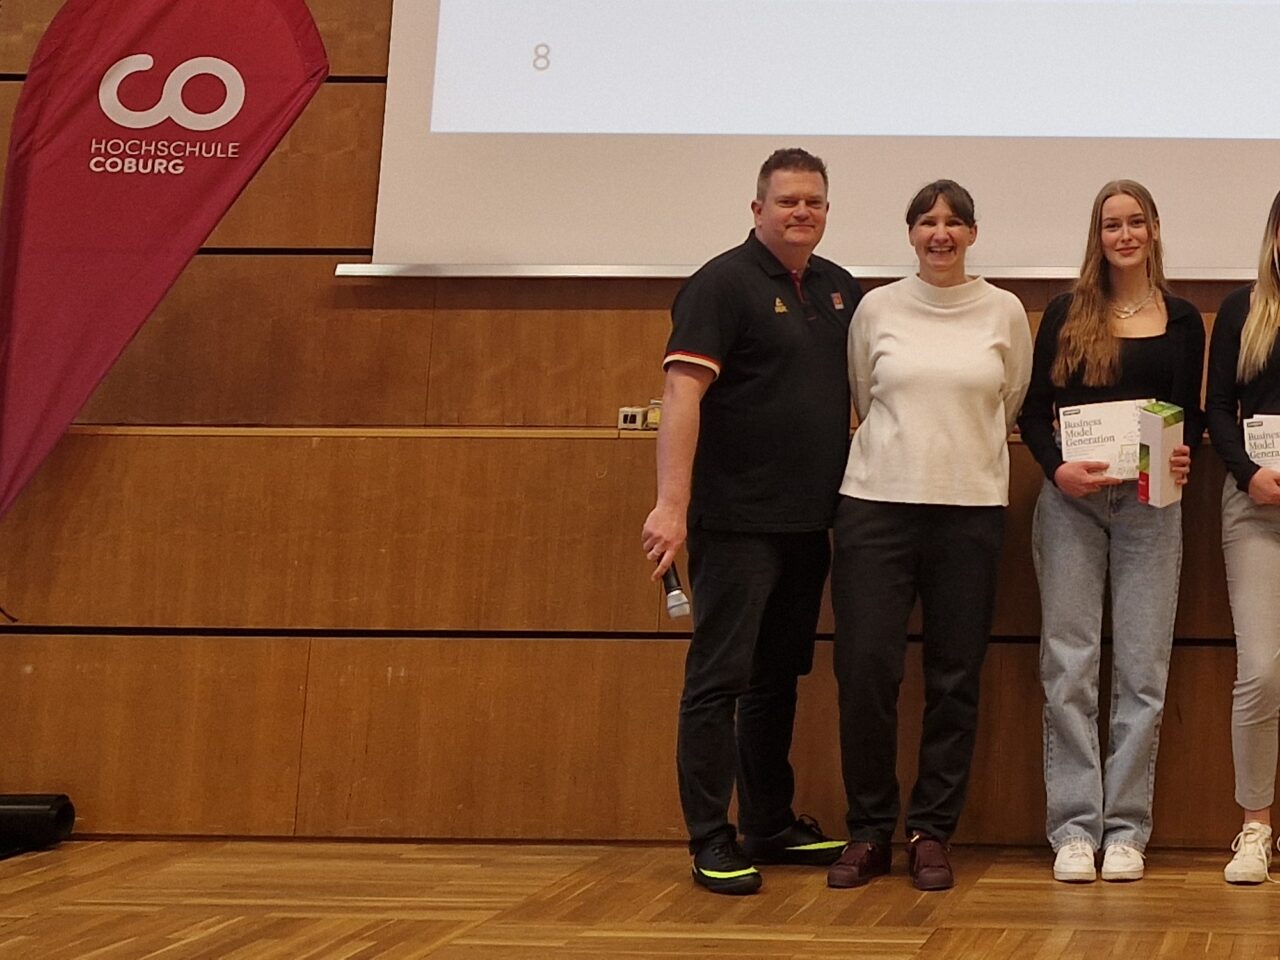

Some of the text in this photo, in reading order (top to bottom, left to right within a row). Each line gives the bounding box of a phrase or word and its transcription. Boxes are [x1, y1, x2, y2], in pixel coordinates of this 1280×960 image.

[533, 44, 551, 71] 8
[90, 138, 240, 159] HOCHSCHULE
[89, 157, 185, 175] COBURG
[1065, 419, 1102, 429] Business
[1066, 427, 1093, 439] Model
[1066, 434, 1116, 447] Generation
[1248, 440, 1275, 450] Model
